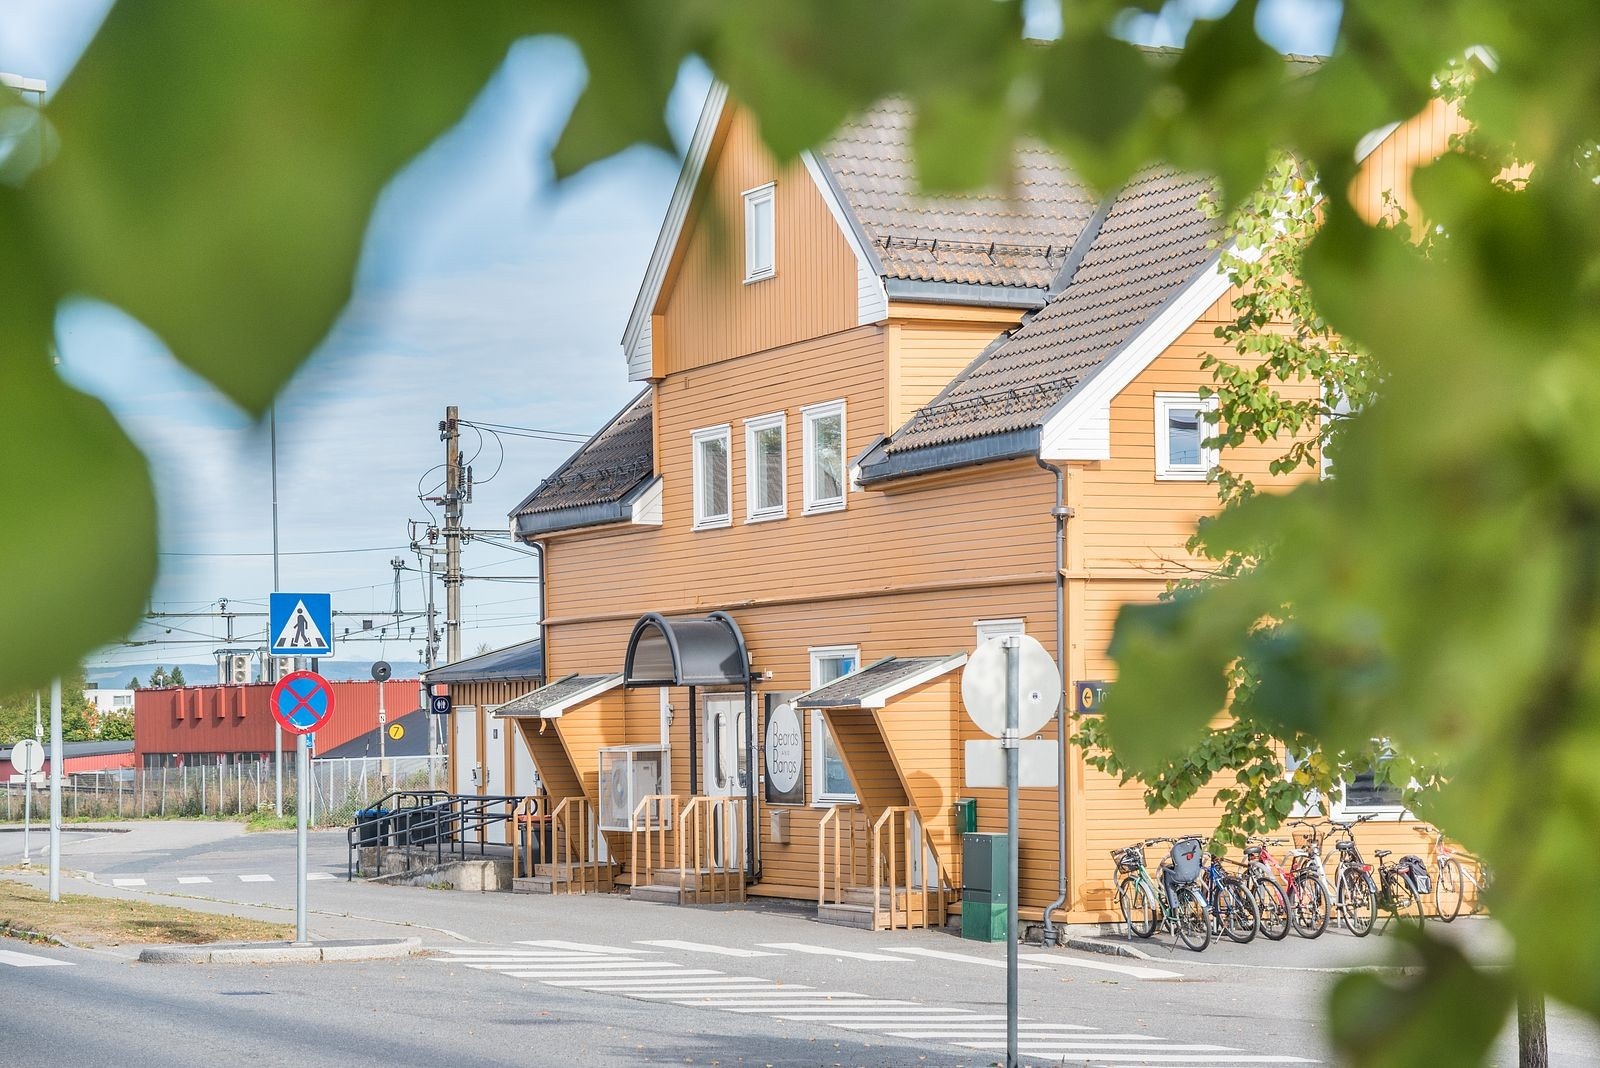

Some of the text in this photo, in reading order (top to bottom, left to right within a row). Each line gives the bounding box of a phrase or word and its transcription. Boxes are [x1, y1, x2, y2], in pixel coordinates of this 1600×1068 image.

[393, 726, 400, 738] 7
[773, 721, 799, 748] Beards
[773, 748, 797, 779] Bangs
